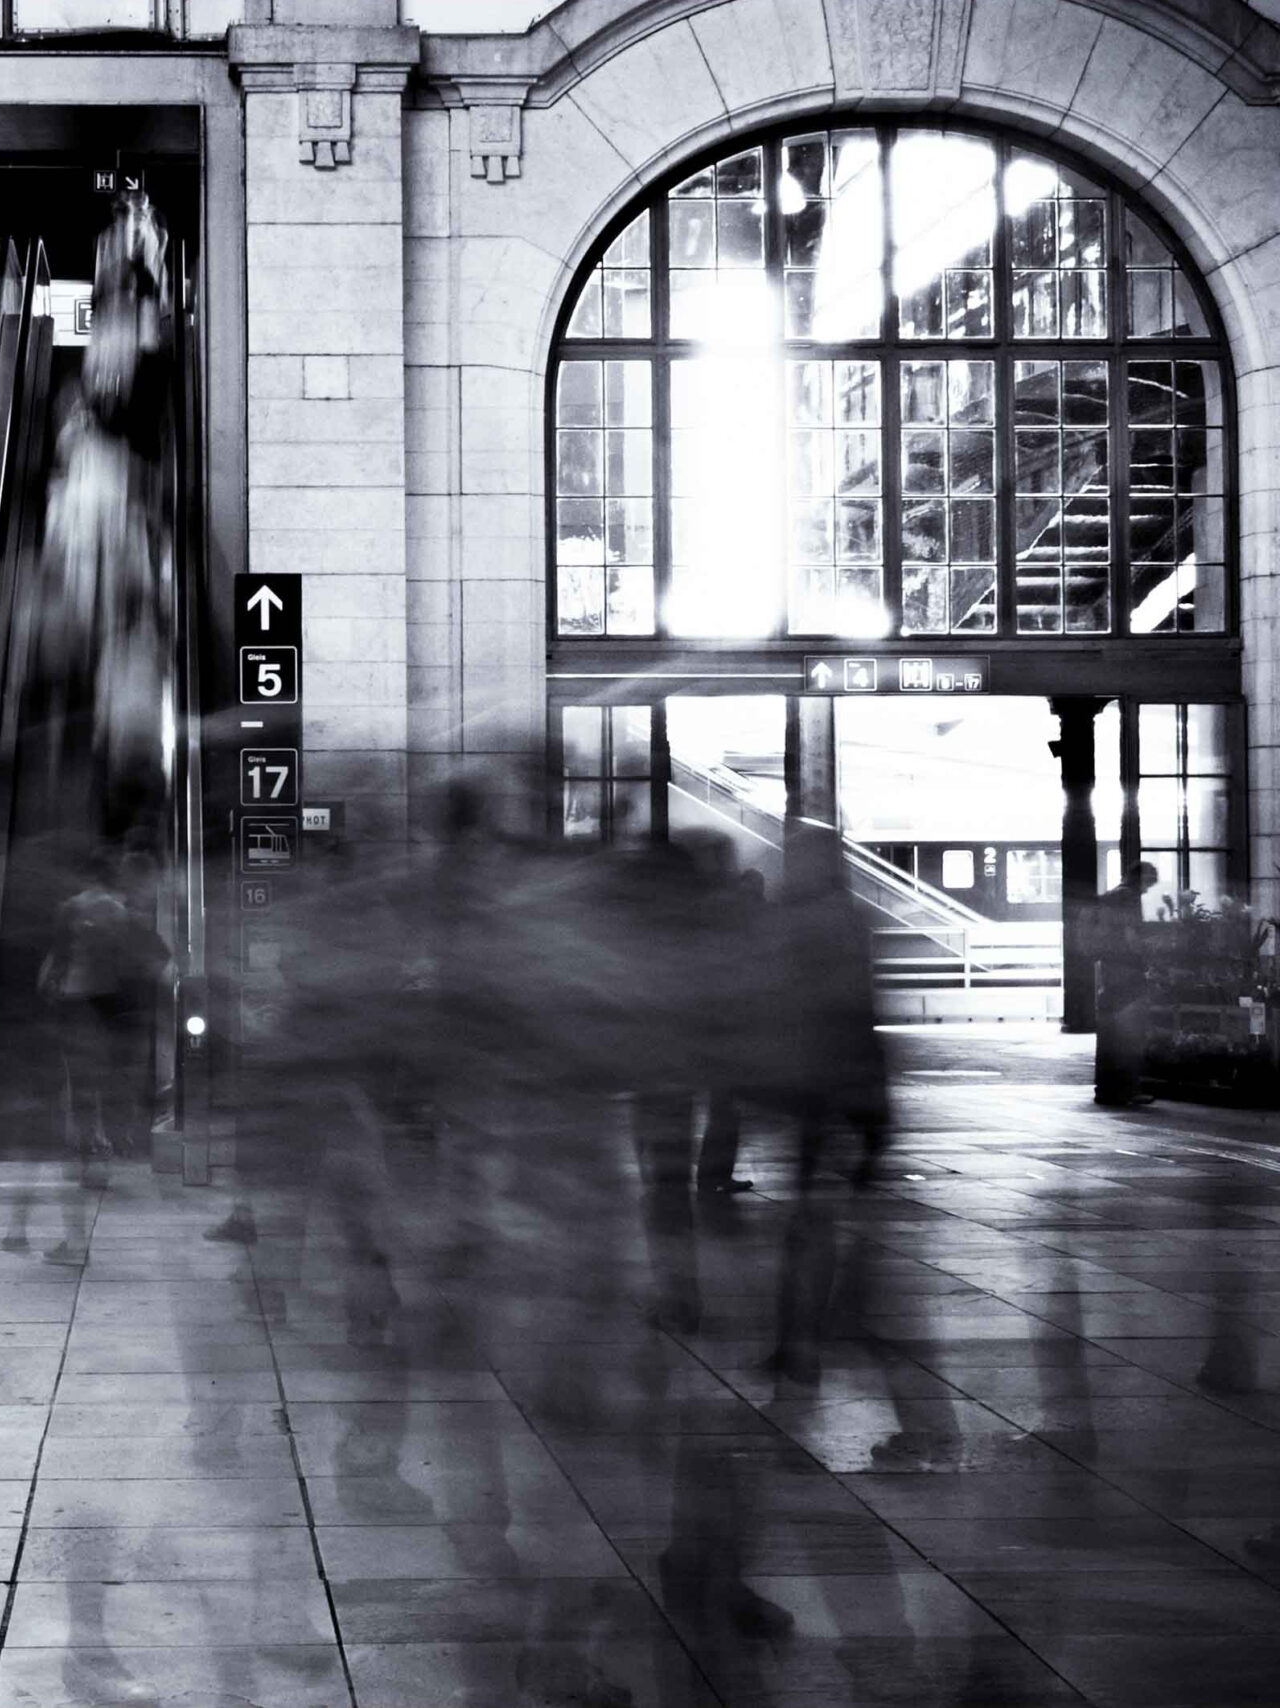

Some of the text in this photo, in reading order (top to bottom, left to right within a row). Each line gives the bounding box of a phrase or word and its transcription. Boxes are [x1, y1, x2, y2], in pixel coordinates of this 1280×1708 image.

[257, 664, 282, 697] 5
[248, 766, 289, 799] 17
[984, 846, 997, 864] 2
[246, 888, 266, 904] 16
